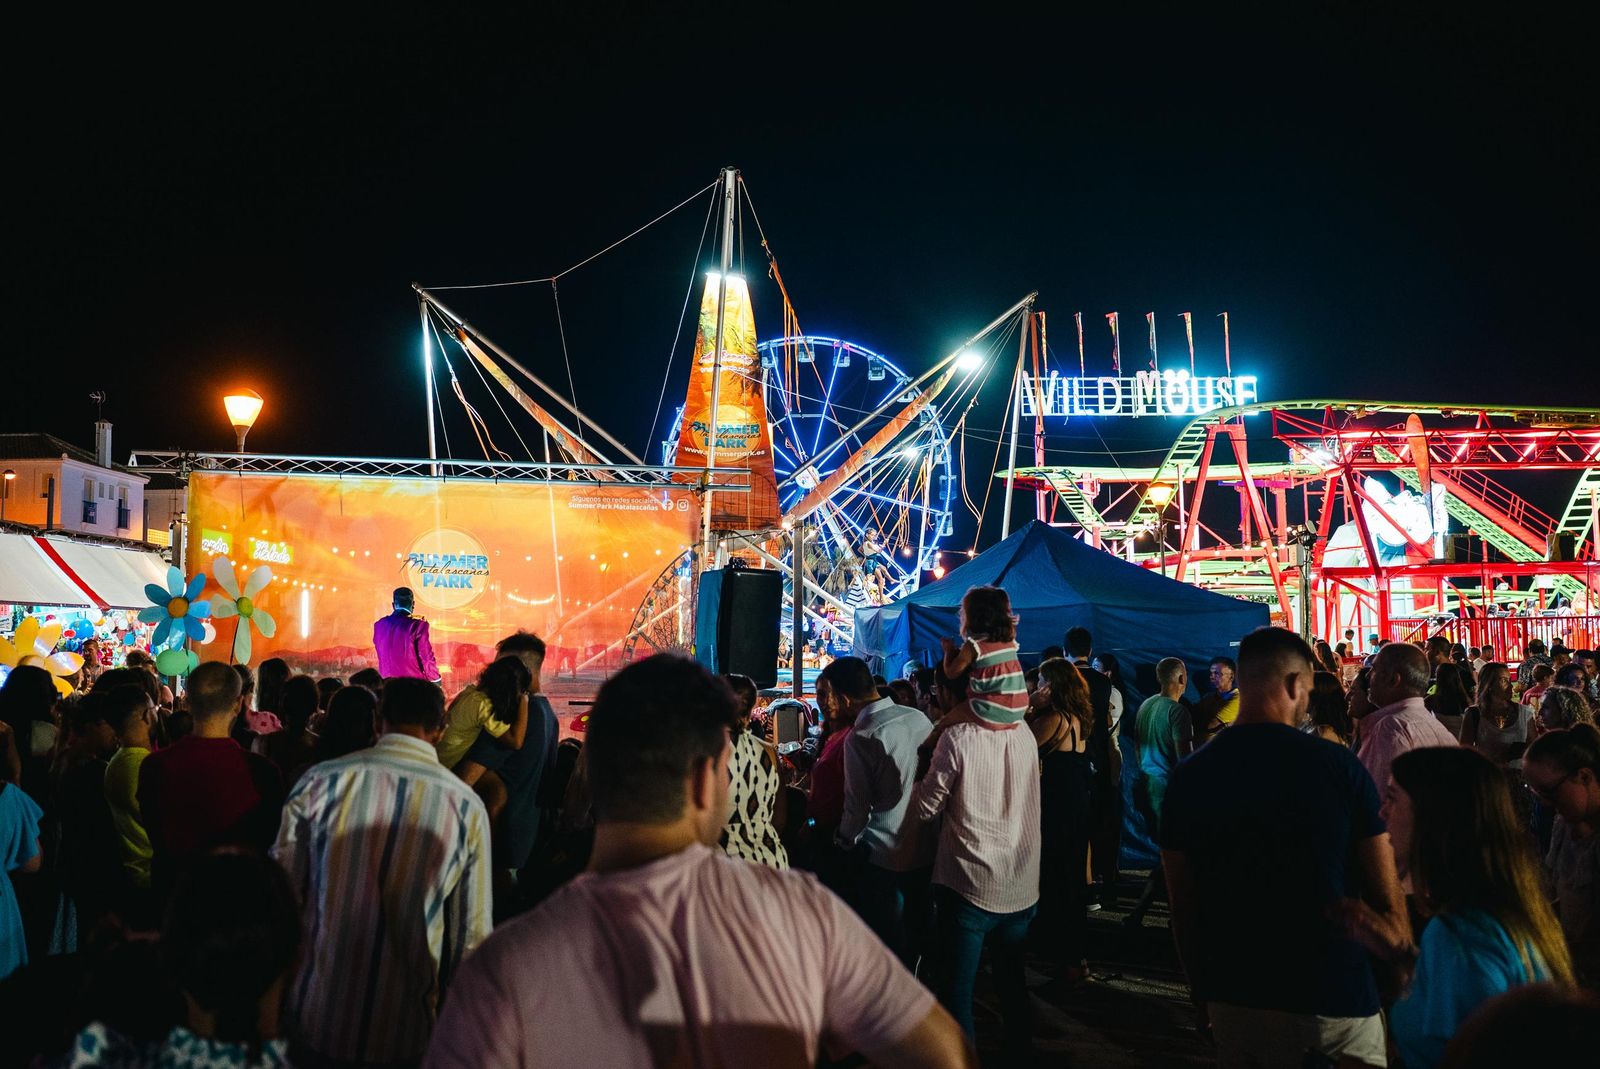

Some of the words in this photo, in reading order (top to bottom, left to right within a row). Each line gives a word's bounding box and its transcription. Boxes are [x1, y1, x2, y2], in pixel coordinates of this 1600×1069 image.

[1022, 370, 1122, 415] WILD
[1136, 369, 1257, 415] MOUSE
[693, 421, 760, 434] SUMMER
[684, 446, 765, 458] www.smmerpark.es
[408, 553, 489, 569] SUMMER
[423, 573, 473, 588] PARK
